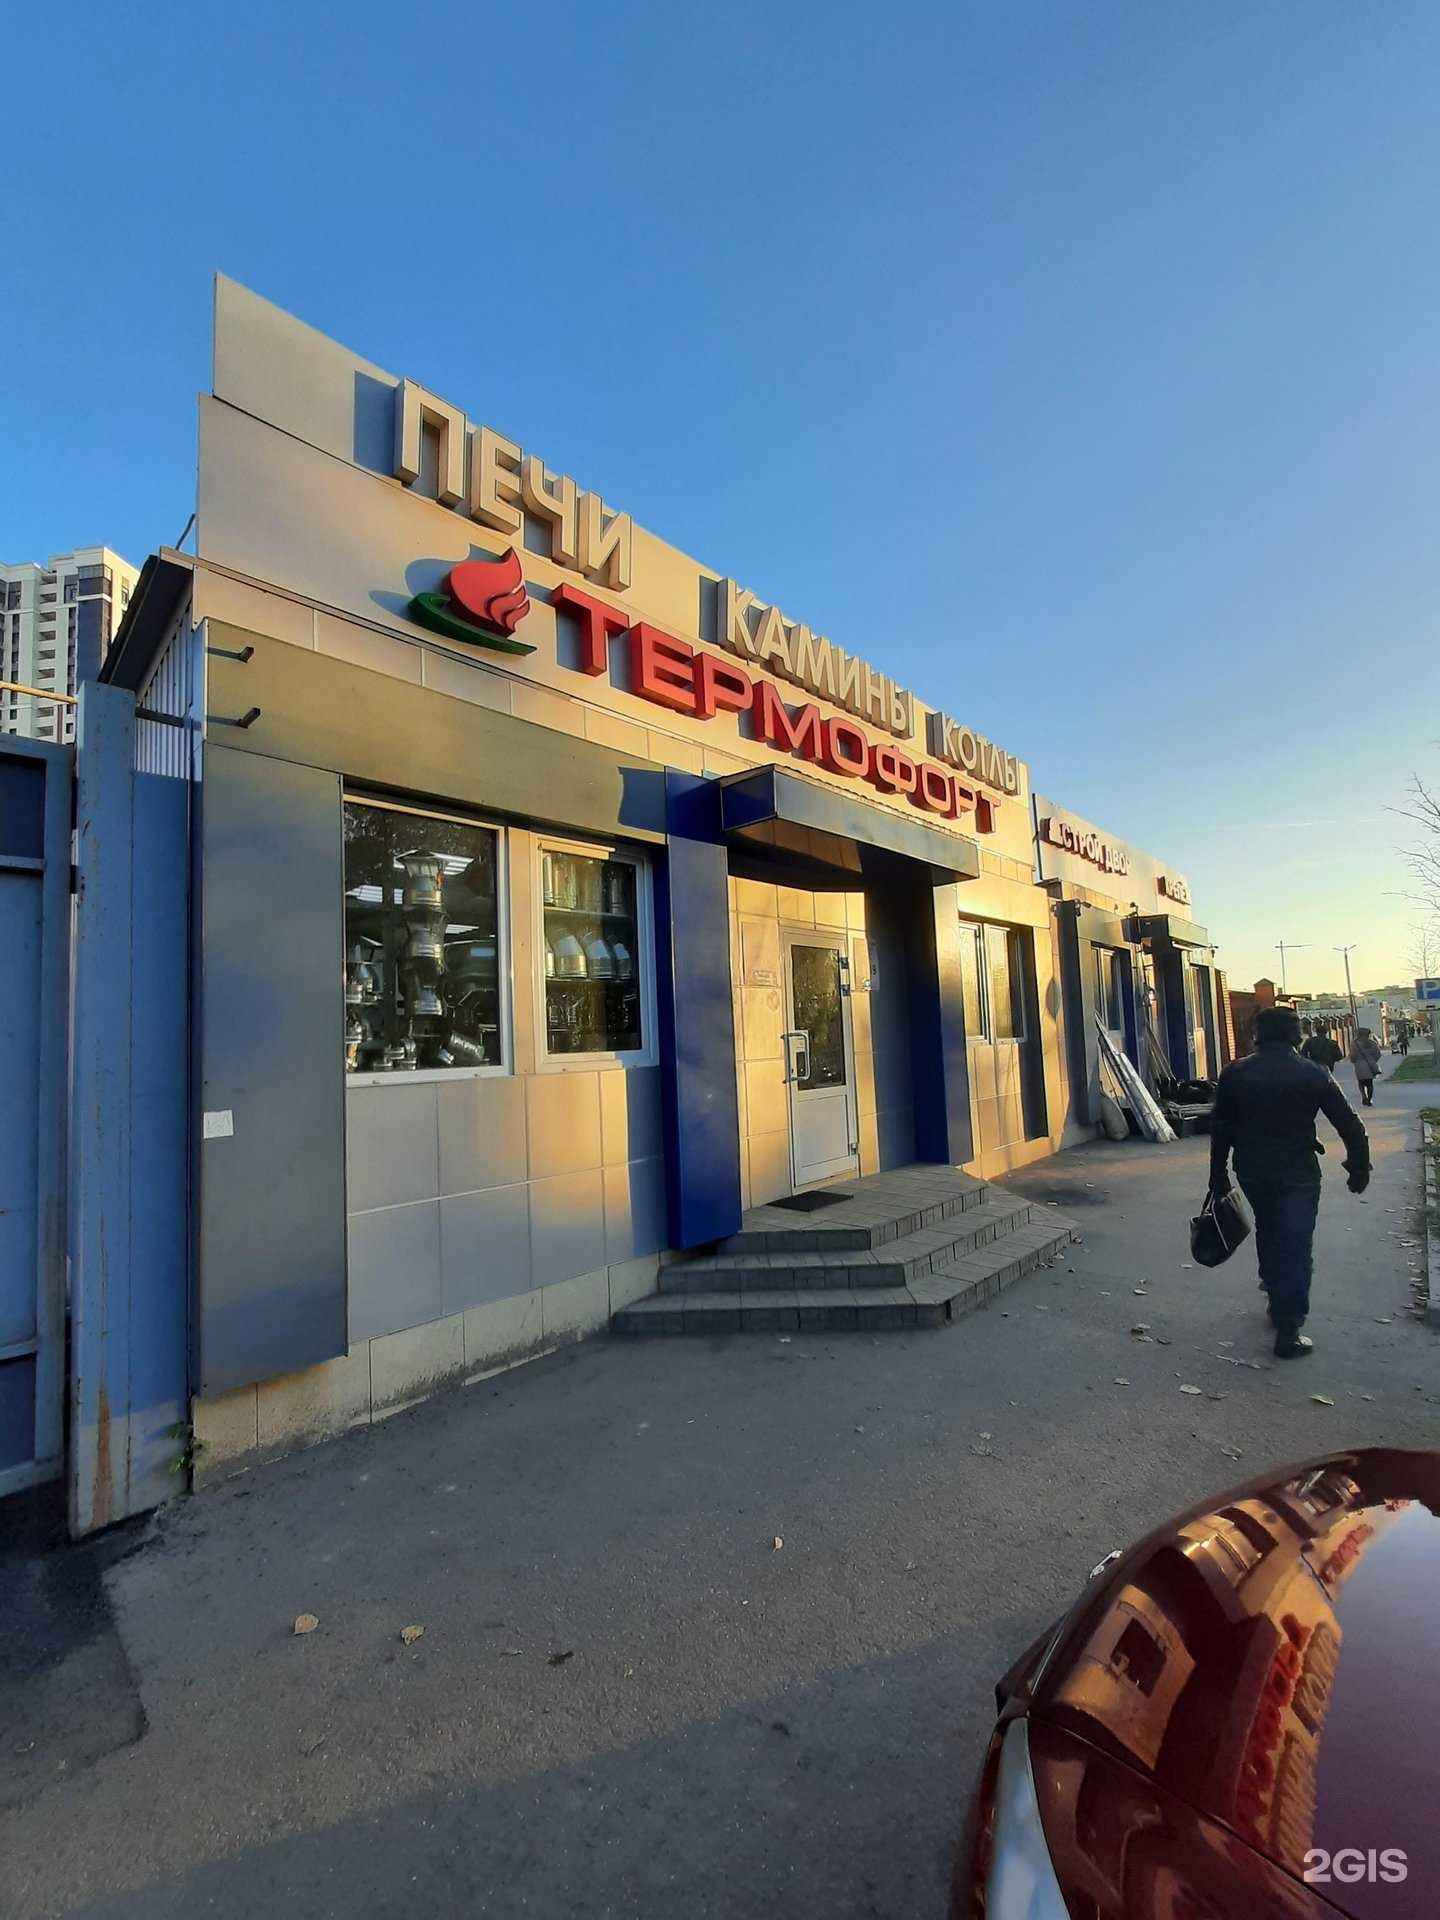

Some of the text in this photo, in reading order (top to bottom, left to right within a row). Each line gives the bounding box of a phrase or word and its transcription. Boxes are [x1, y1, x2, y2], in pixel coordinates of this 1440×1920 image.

[395, 377, 1020, 794] ПЕЧИ КАМИНЫ КОТЛЫ
[552, 581, 1001, 834] ТЕРМОФОРТ
